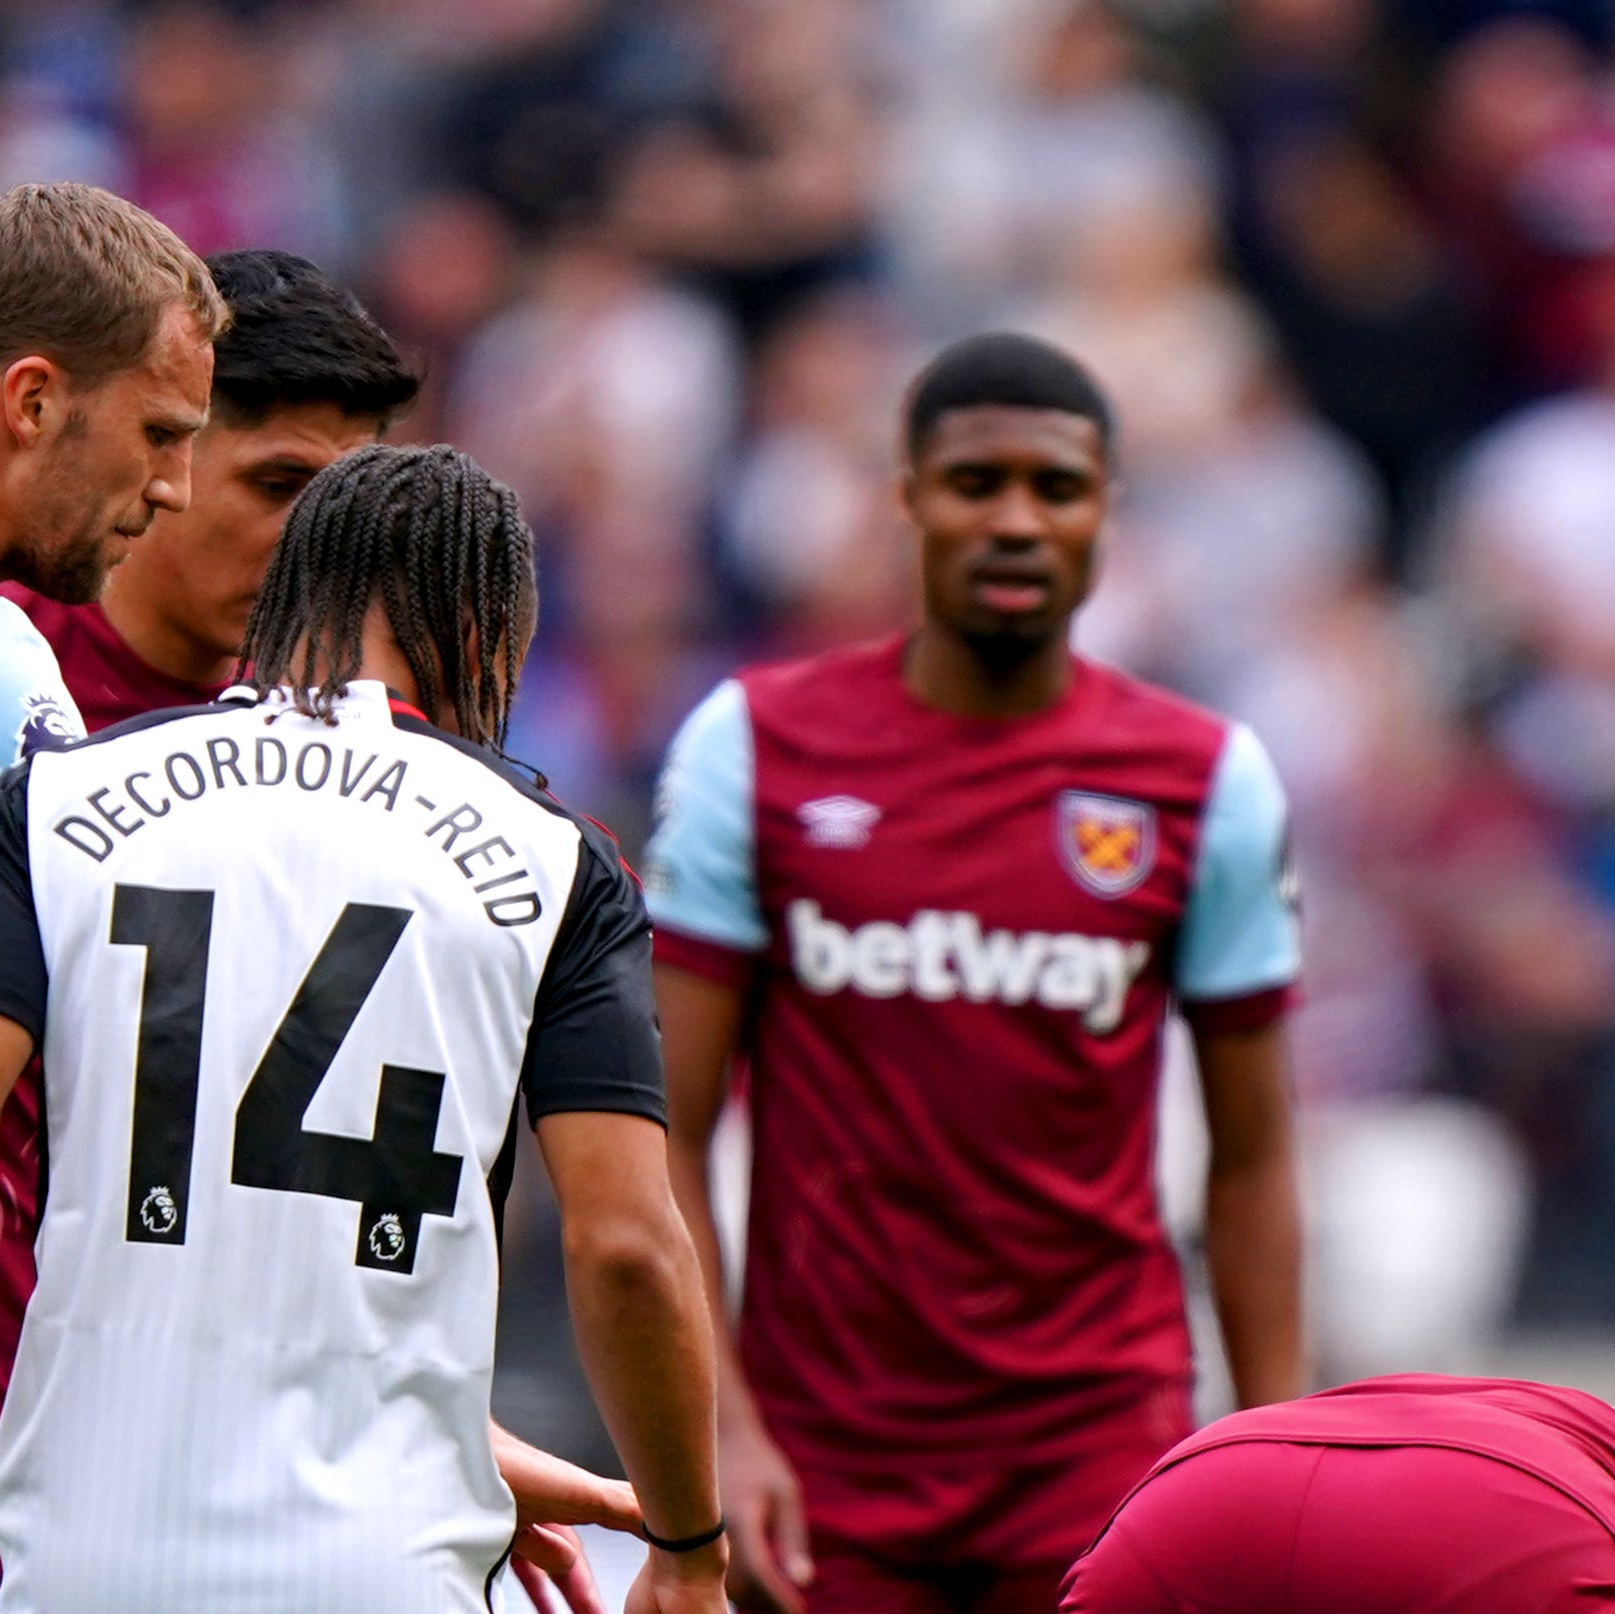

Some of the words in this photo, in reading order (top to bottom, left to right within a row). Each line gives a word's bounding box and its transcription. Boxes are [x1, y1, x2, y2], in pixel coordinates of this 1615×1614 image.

[54, 736, 542, 928] DECORDOVA-REID
[787, 899, 1151, 1034] betway
[109, 883, 464, 1276] 14
